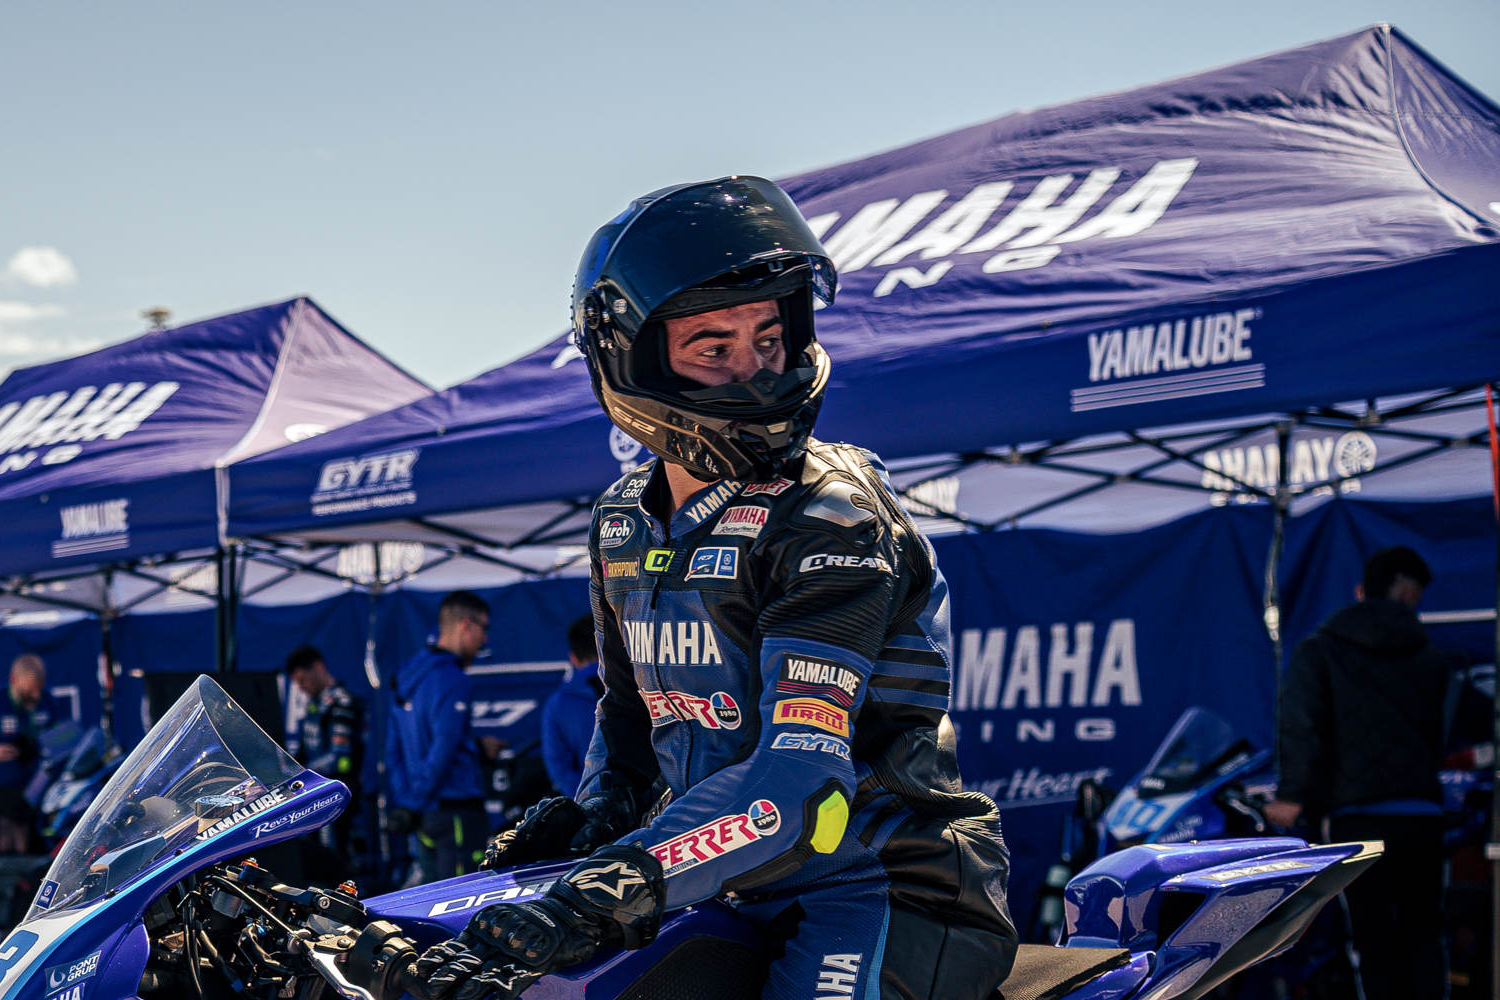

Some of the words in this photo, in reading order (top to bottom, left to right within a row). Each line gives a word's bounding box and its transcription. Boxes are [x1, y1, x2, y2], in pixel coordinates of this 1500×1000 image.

[810, 157, 1198, 275] MAHA
[1088, 307, 1254, 383] YAMALUBE
[319, 449, 420, 493] GYTR
[621, 488, 643, 499] GRU
[684, 478, 743, 524] YAMAH
[600, 519, 630, 539] Airoh
[624, 621, 722, 665] YAMAHA
[788, 659, 861, 697] YAMALUBE
[950, 619, 1142, 711] MAHA
[781, 703, 844, 731] PIRELLI
[955, 718, 1116, 742] ING
[771, 732, 852, 760] GYTR
[195, 788, 288, 841] YAMALUBE
[313, 793, 340, 812] Heart
[67, 964, 97, 982] GRUP
[69, 955, 99, 973] PONT
